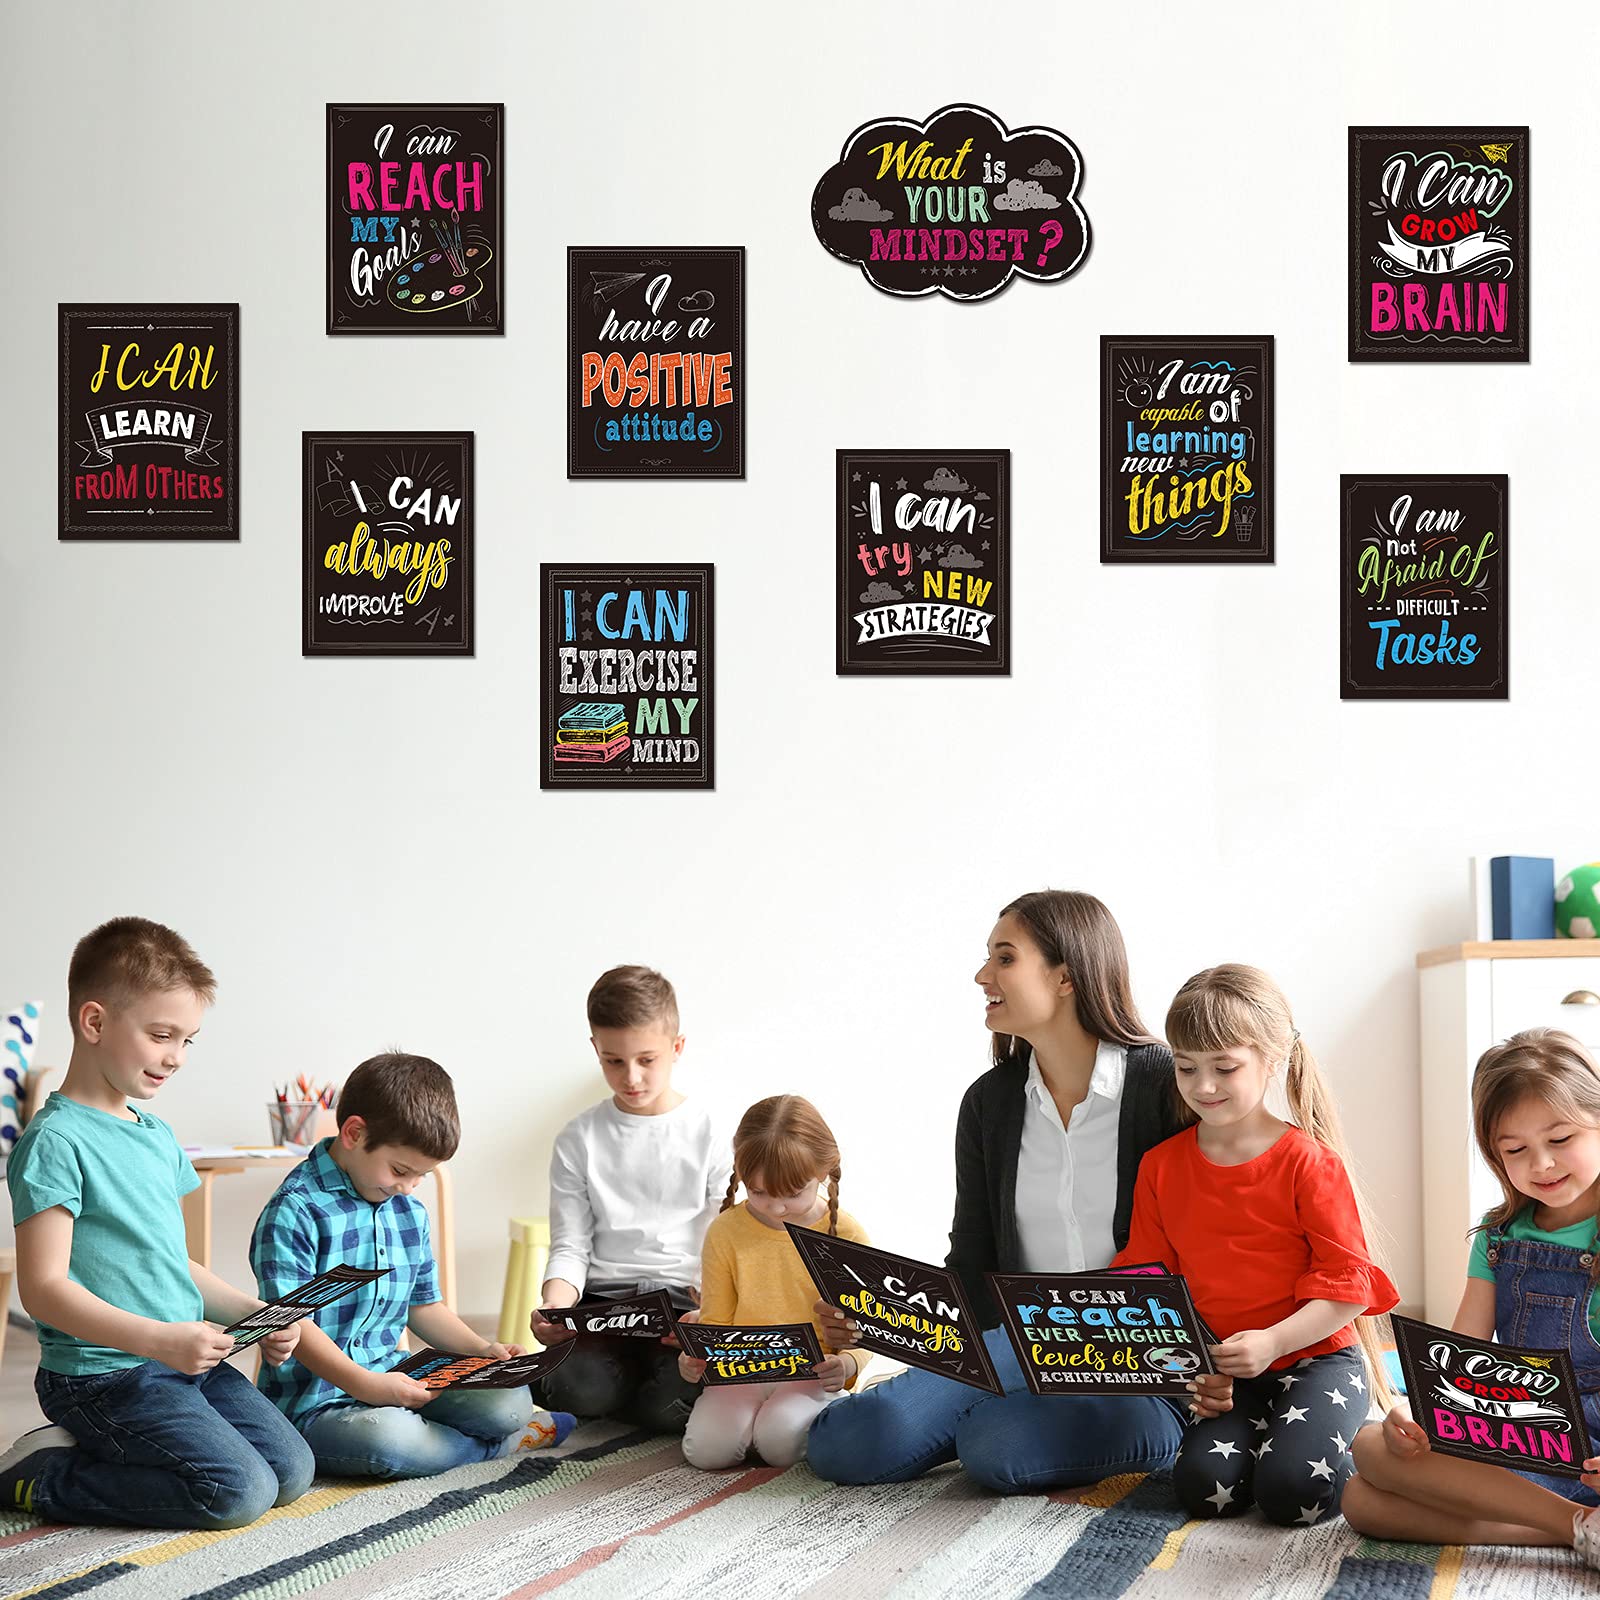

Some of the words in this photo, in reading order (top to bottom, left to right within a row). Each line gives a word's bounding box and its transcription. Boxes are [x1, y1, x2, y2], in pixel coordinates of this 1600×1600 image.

[374, 123, 394, 158] I
[406, 135, 457, 155] can
[867, 138, 974, 181] What
[983, 153, 1006, 183] is
[348, 162, 483, 211] REACH
[1382, 159, 1407, 207] I
[1417, 160, 1506, 212] Can
[904, 186, 992, 223] YOUR
[351, 217, 399, 242] MY
[1402, 208, 1478, 241] GROW
[351, 226, 423, 296] Goals
[1417, 246, 1456, 272] MY
[645, 274, 672, 316] I
[1371, 282, 1508, 332] BRAIN
[599, 308, 682, 344] have
[688, 317, 715, 339] a
[91, 344, 111, 393] I
[116, 343, 218, 391] CAN
[582, 352, 733, 408] POSITIVE
[1157, 360, 1184, 400] I
[1180, 372, 1232, 395] am
[100, 409, 195, 439] LEARN
[606, 412, 713, 441] attitude
[1140, 400, 1204, 430] capable
[1210, 390, 1241, 423] of
[1127, 421, 1246, 460] learning
[75, 464, 138, 499] FROM
[145, 464, 224, 499] OTHERS
[1120, 456, 1174, 472] new
[350, 480, 367, 513] I
[389, 476, 461, 525] CAN
[870, 481, 883, 534] I
[895, 492, 976, 534] can
[1125, 460, 1252, 537] things
[1390, 495, 1412, 535] I
[1415, 509, 1466, 534] am
[324, 522, 455, 606] always
[857, 542, 912, 576] try
[1358, 545, 1447, 603] Afraid
[1450, 531, 1499, 587] Of
[319, 593, 404, 616] IMPROVE
[923, 570, 993, 607] NEW
[1397, 599, 1459, 615] DIFFICULT
[564, 590, 576, 641] I
[596, 590, 690, 642] CAN
[864, 606, 988, 638] STRATEGIES
[1368, 619, 1481, 670] Tasks
[559, 647, 697, 694] EXERCISE
[634, 698, 699, 735] MY
[632, 739, 699, 762] MIND
[843, 1264, 867, 1286] I
[883, 1275, 960, 1321] CAN
[1049, 1289, 1062, 1303] I
[1070, 1290, 1126, 1304] CAN
[587, 1313, 648, 1331] can
[840, 1290, 965, 1353] always
[1016, 1298, 1184, 1327] reach
[704, 1347, 801, 1356] learning
[722, 1331, 742, 1342] I
[742, 1334, 781, 1342] am
[855, 1320, 928, 1353] MPROVE
[1023, 1327, 1084, 1342] EVER
[713, 1355, 809, 1378] things
[1032, 1344, 1108, 1371] levels
[1112, 1347, 1139, 1370] of
[1429, 1344, 1451, 1370] I
[1465, 1355, 1552, 1389] Can
[1040, 1371, 1163, 1384] ACHIEVEMENT
[1454, 1377, 1531, 1400] GROW
[1474, 1399, 1512, 1416] MY
[1433, 1408, 1574, 1463] BRAIN
